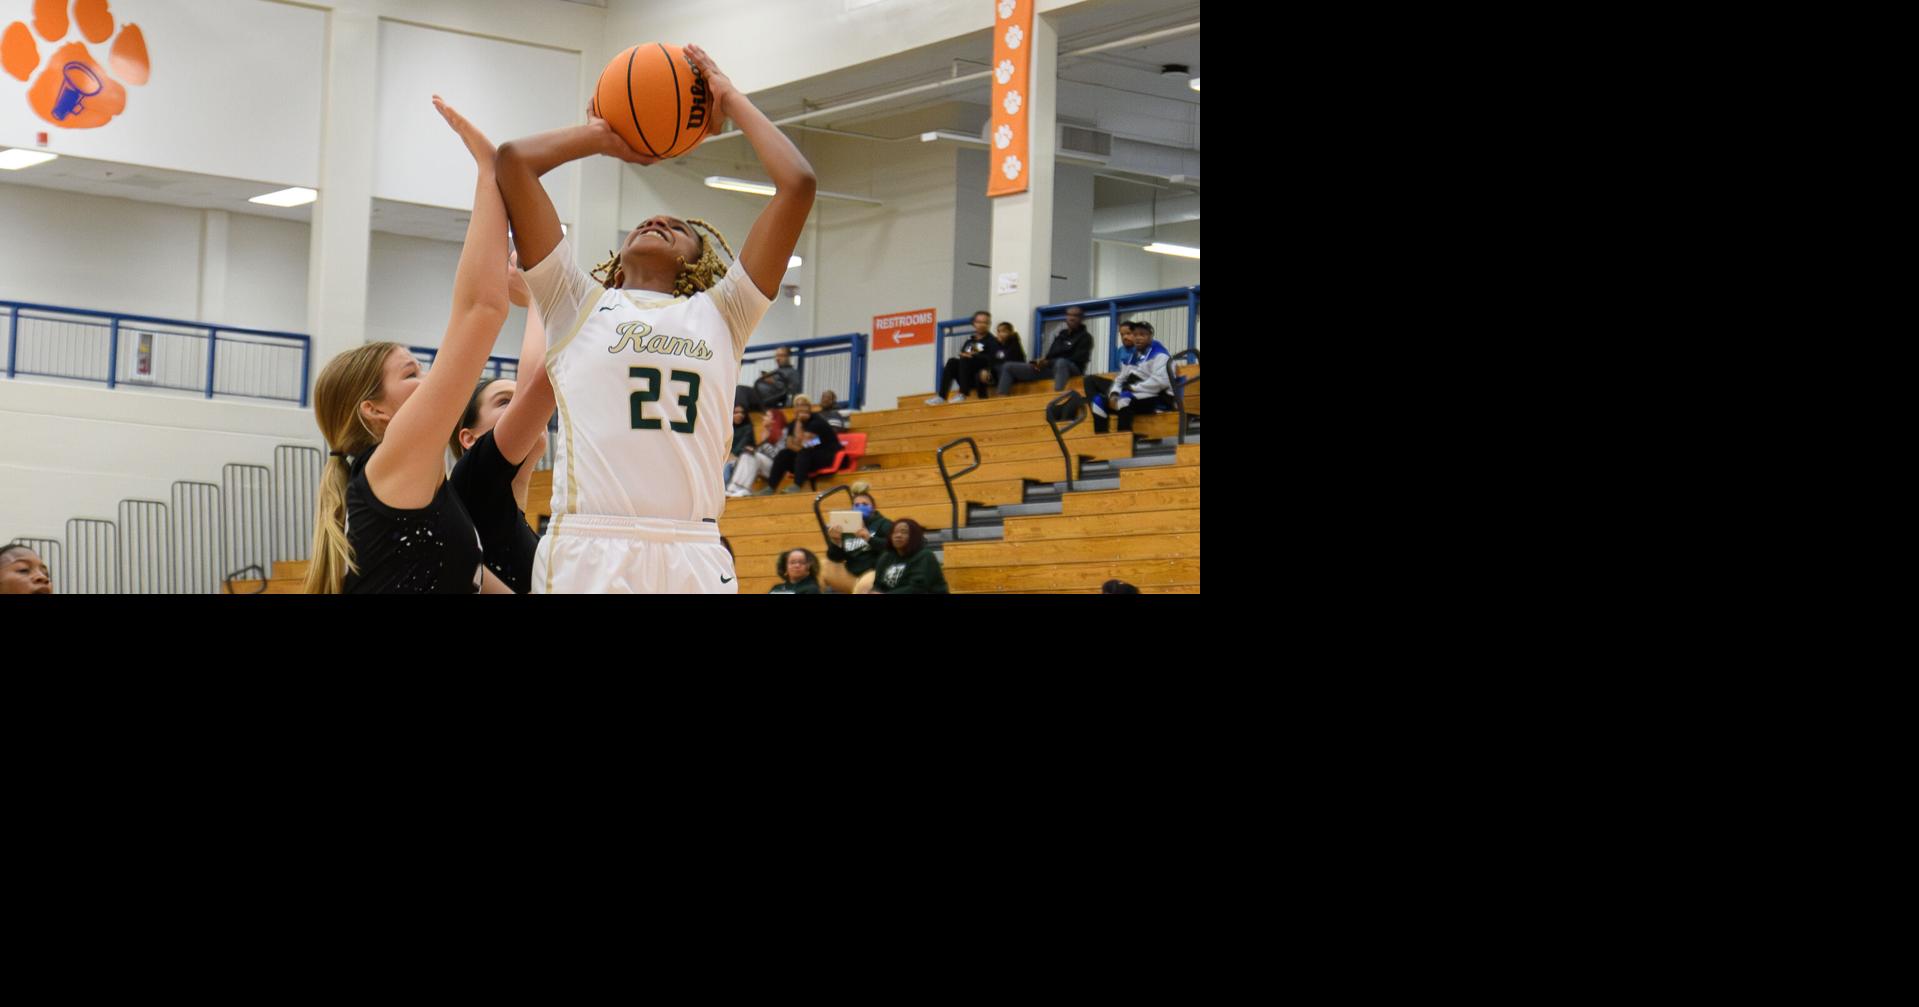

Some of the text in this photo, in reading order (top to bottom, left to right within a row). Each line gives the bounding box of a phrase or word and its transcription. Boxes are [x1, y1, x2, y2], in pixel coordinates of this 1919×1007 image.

[608, 320, 713, 361] Rams
[876, 312, 933, 330] RESTROOMS
[628, 366, 701, 434] 23
